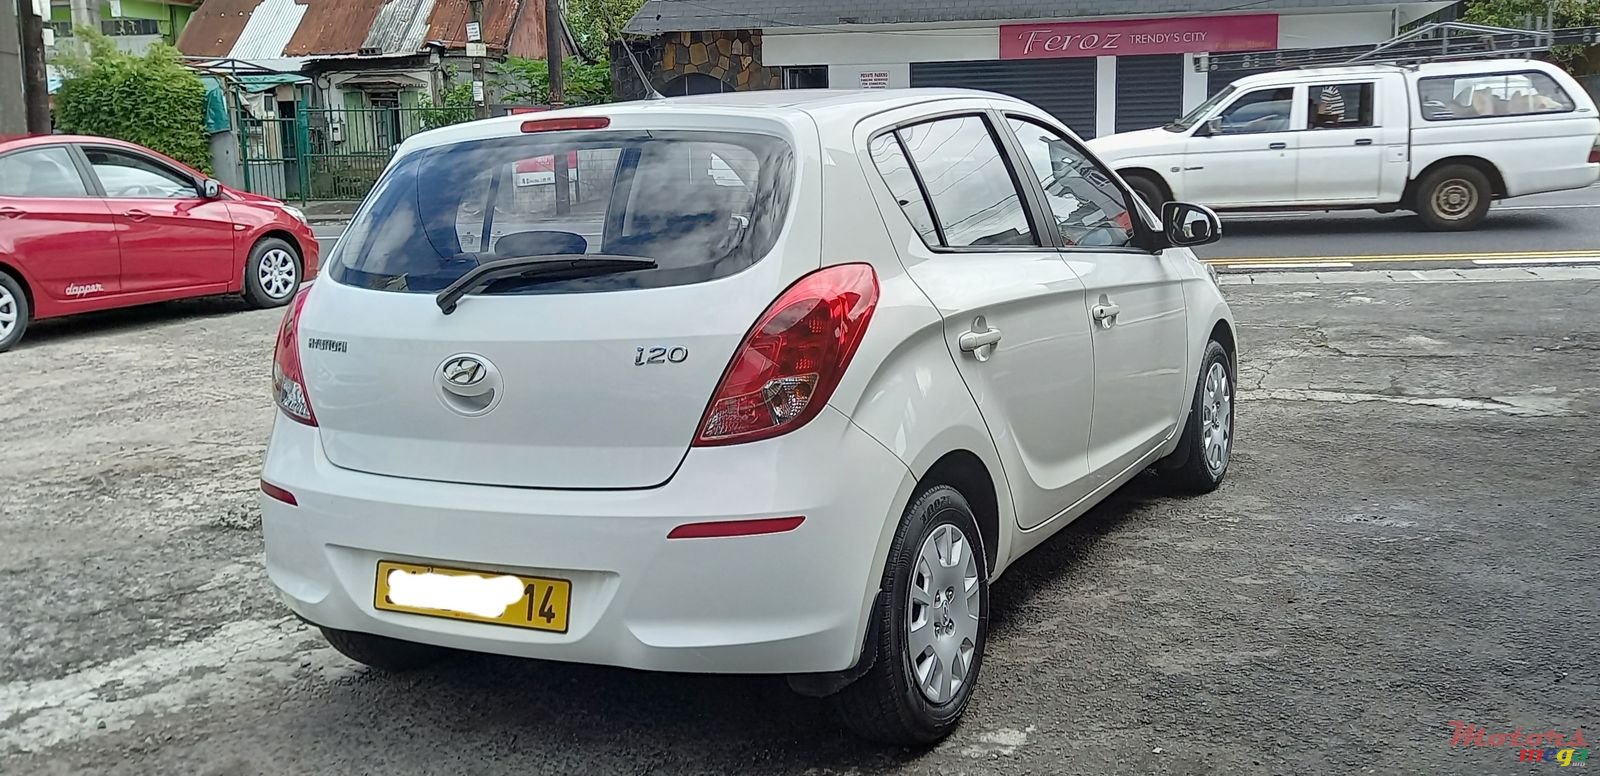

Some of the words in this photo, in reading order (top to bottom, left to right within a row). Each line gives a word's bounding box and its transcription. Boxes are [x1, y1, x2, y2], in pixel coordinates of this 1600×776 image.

[1018, 29, 1121, 55] Feroz
[1129, 33, 1180, 44] TRENDY'S
[1183, 32, 1207, 42] CITY
[308, 338, 347, 353] HYUNDAI
[634, 346, 688, 366] i20
[523, 583, 556, 624] 14
